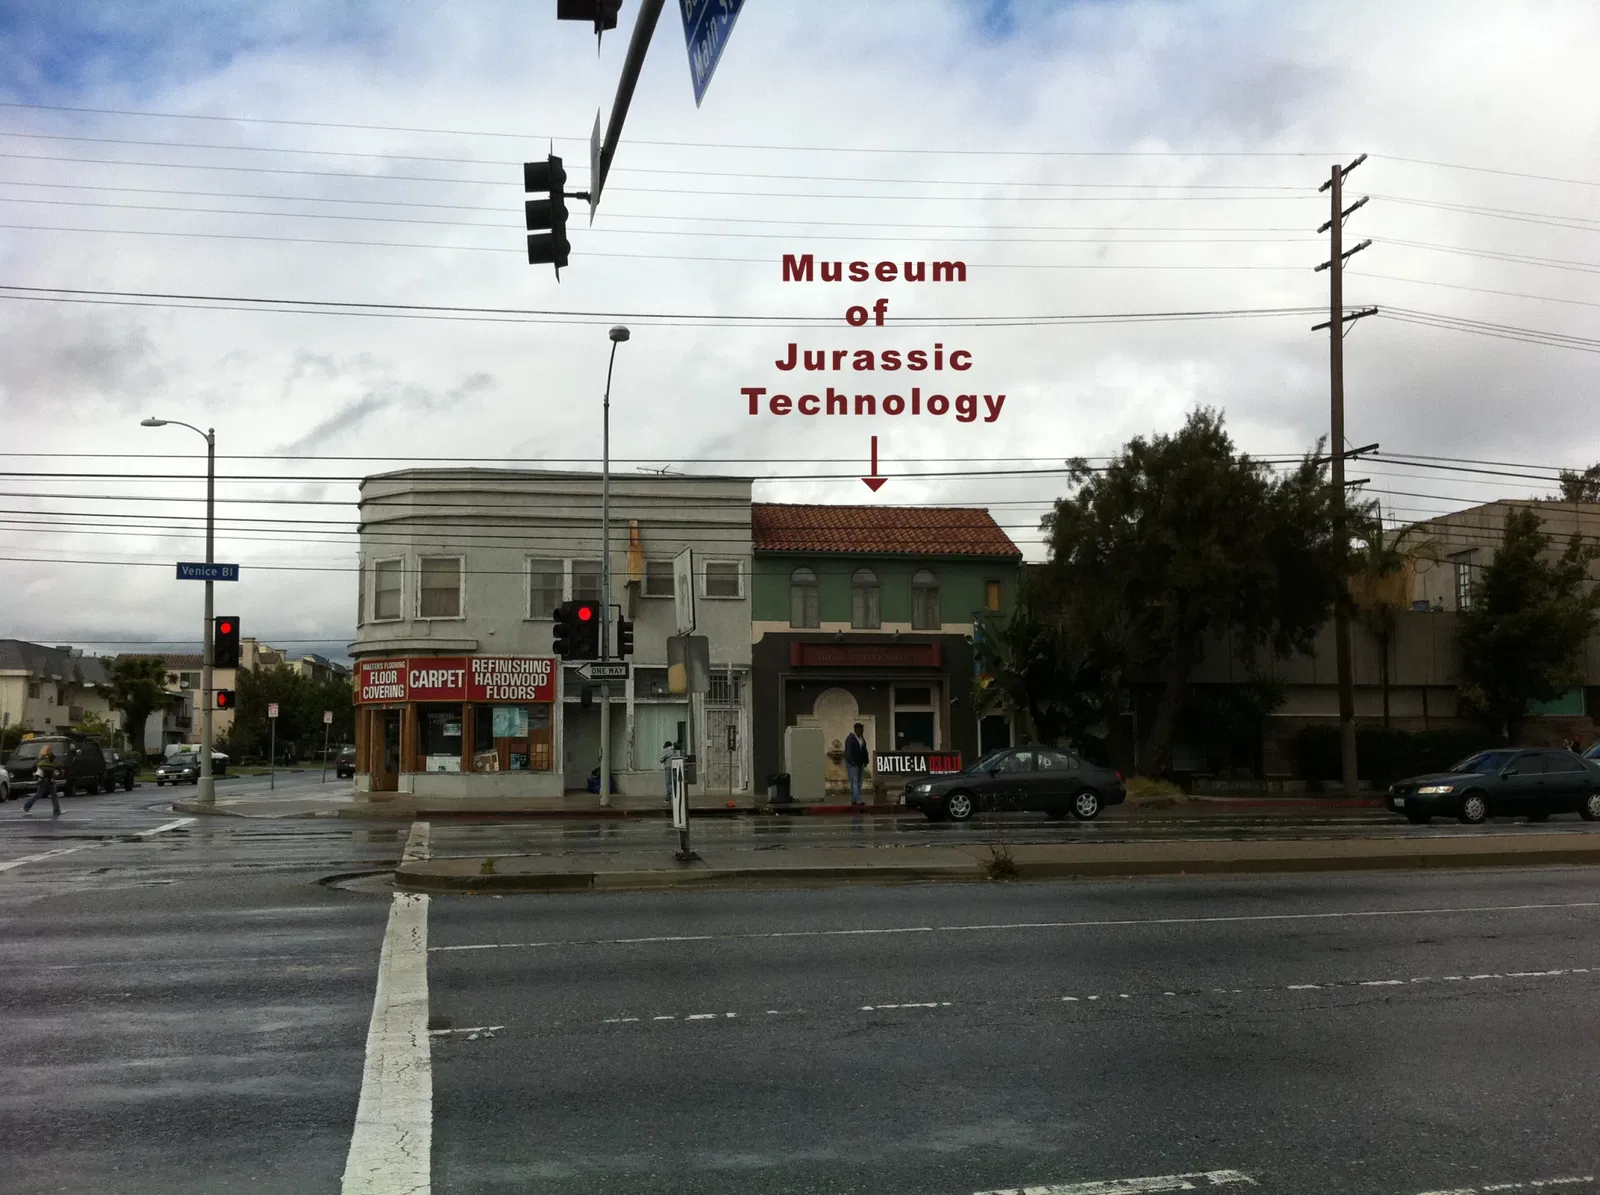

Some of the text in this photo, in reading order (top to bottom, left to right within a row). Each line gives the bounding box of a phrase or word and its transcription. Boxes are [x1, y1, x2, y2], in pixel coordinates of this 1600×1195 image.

[693, 16, 719, 86] Main
[181, 566, 233, 577] Venice Bl
[472, 659, 551, 673] REFINISHING
[591, 667, 625, 675] ONE WAY
[370, 670, 398, 685] FLOOR
[409, 669, 466, 688] CARPET
[475, 672, 548, 687] HARDWOOD
[362, 684, 405, 699] COVERING
[486, 686, 536, 700] FLOORS
